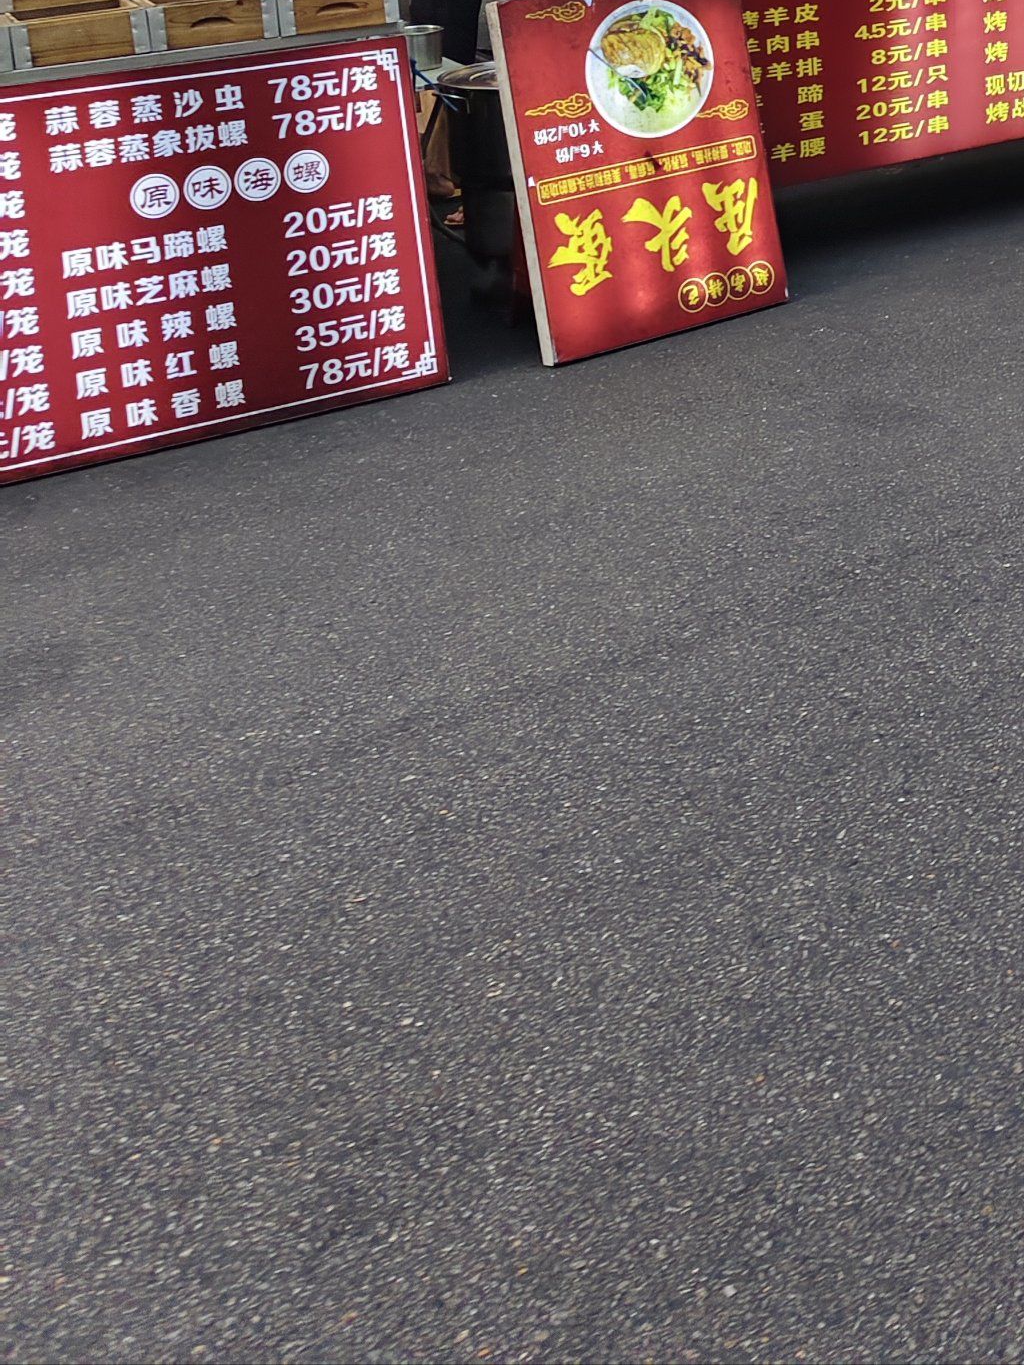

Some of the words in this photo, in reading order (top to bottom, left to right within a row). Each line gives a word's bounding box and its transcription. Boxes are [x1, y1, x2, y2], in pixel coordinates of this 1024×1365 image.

[854, 12, 947, 41] 45元/串
[871, 38, 948, 66] 8元/串
[44, 84, 245, 136] 蒜蓉蒸沙虫
[268, 66, 378, 105] 78元/笼
[855, 91, 949, 121] 20元/串
[857, 64, 948, 93] 12元/只
[49, 120, 249, 175] 蒜蓉蒸象拔螺
[272, 99, 382, 140] 78元/笼
[857, 117, 949, 146] 12元/串
[138, 158, 324, 208] 原味海螺
[62, 225, 228, 280] 原味马蹄螺
[283, 194, 394, 238] 20元/笼
[67, 263, 232, 319] 原味芝麻螺
[287, 232, 397, 277] 20元/笼
[683, 267, 770, 306] 越南特色
[71, 302, 237, 360] 原味辣螺
[290, 269, 401, 314] 30元/笼
[76, 340, 240, 400] 原味红螺
[295, 306, 406, 352] 35元/笼
[81, 379, 246, 440] 原味香螺
[300, 343, 409, 390] 78元/笼
